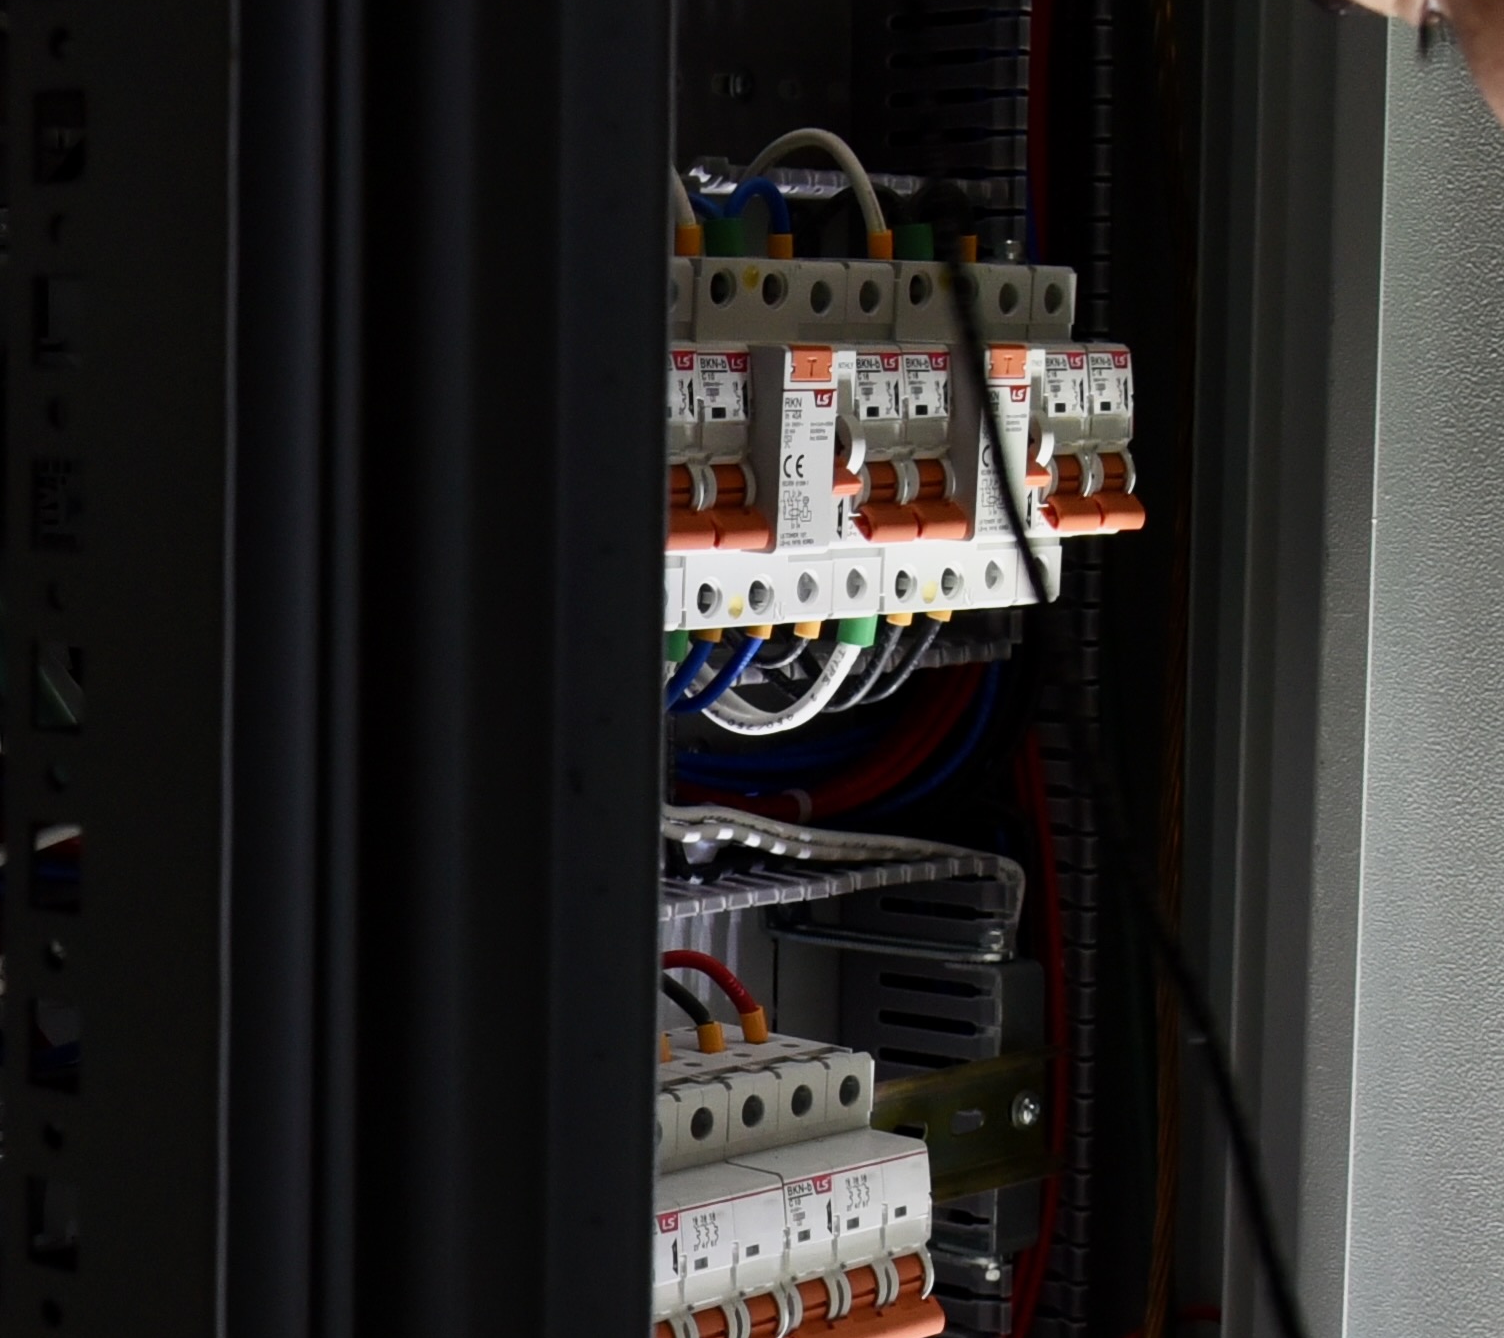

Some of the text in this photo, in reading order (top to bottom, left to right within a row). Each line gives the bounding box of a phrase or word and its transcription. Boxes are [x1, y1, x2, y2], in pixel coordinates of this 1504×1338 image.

[700, 357, 727, 369] BKN-b
[856, 358, 881, 369] BKN-b
[906, 358, 930, 368] BKN-b
[1045, 357, 1068, 367] BKN-b
[784, 397, 803, 408] RKN
[784, 454, 804, 479] CE
[822, 649, 847, 686] TYPE
[787, 1182, 812, 1197] BKN-b
[816, 1177, 830, 1191] LS
[661, 1214, 676, 1230] LS
